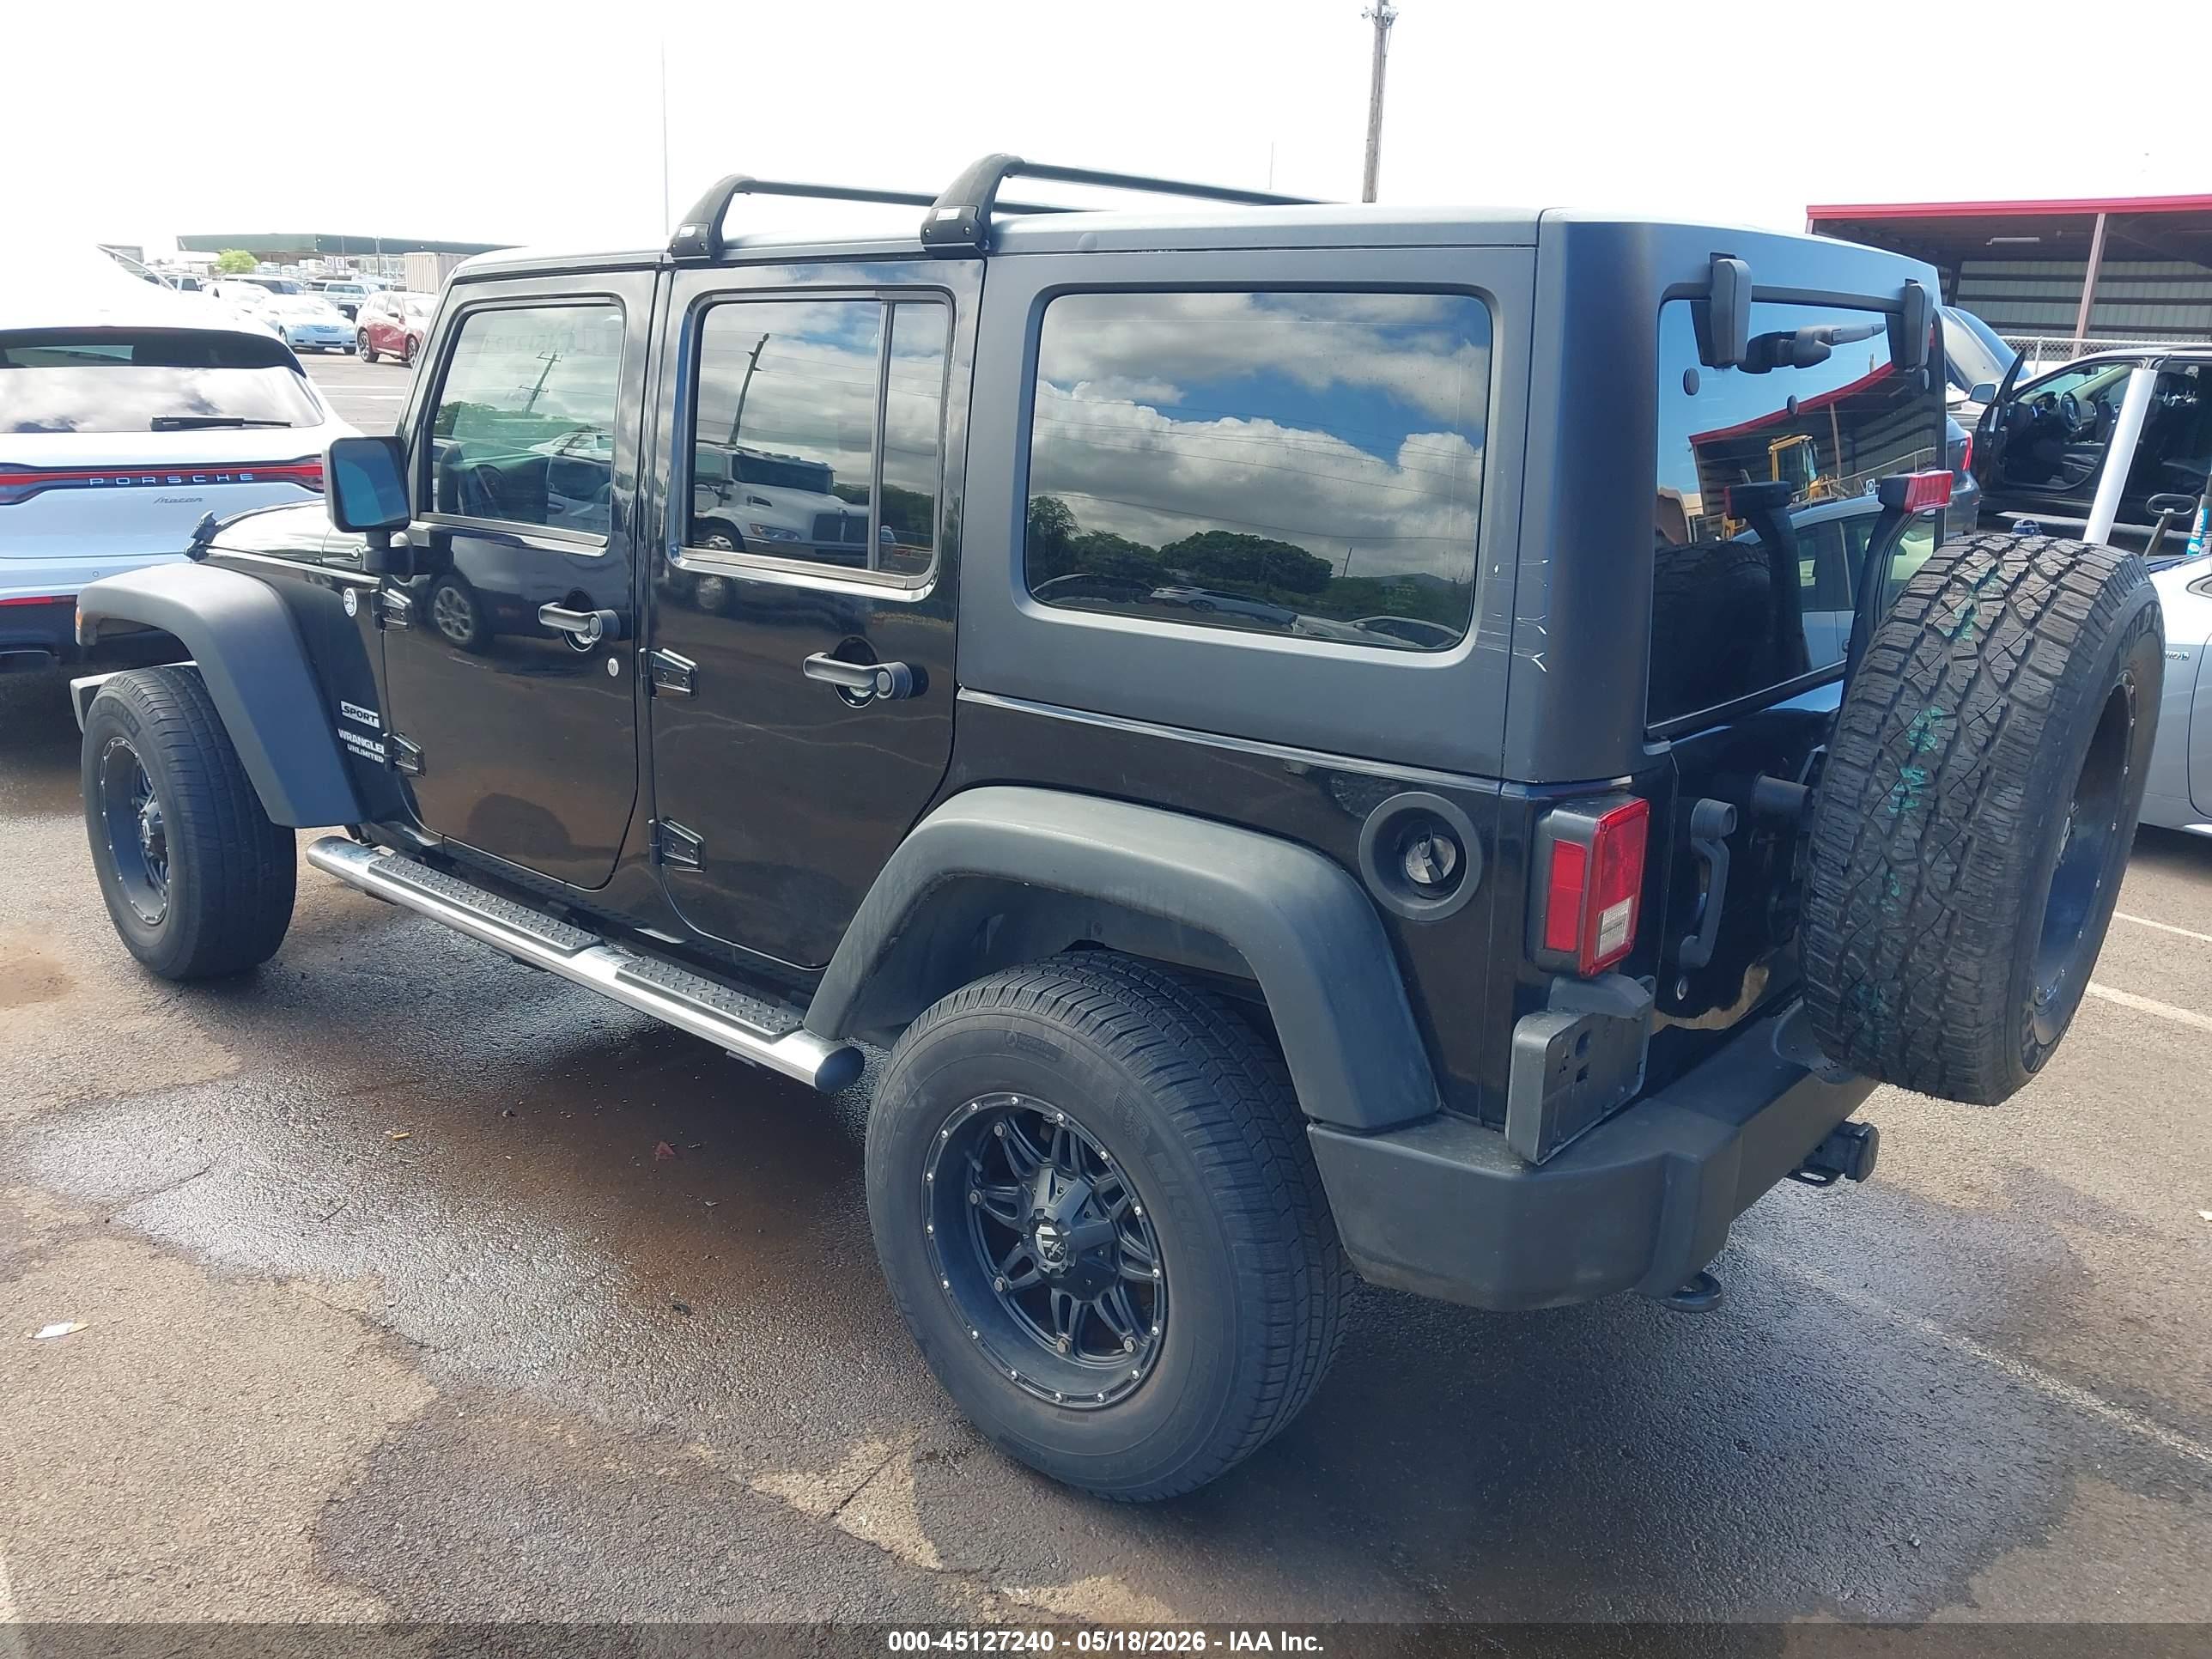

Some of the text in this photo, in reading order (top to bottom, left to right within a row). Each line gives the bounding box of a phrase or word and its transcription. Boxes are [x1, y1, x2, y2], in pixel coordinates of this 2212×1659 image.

[89, 473, 253, 486] PORSCHE
[153, 496, 204, 505] Macan
[343, 705, 379, 723] SPORT
[347, 743, 385, 763] UNLIMITED
